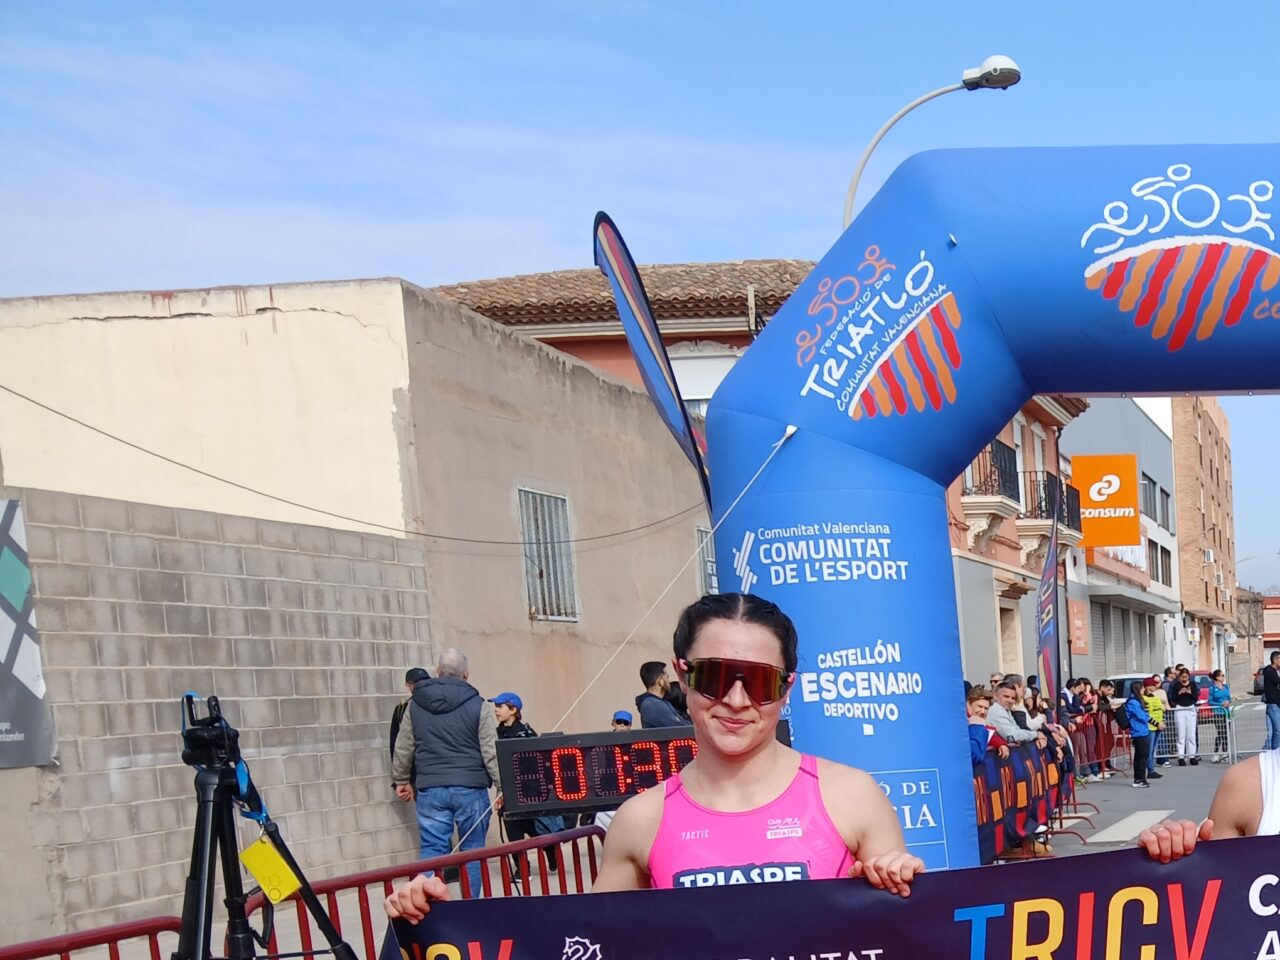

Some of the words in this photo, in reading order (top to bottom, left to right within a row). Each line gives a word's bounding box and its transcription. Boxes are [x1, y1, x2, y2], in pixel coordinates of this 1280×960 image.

[800, 250, 934, 399] TRIATLÓ
[820, 288, 872, 356] FEDERACIÓ
[874, 273, 892, 291] DE
[836, 341, 881, 412] COMUNITAT
[882, 283, 947, 343] VALENCIANA
[1081, 507, 1135, 518] consum
[758, 524, 820, 540] Comunitat
[822, 521, 890, 535] Valenciana
[759, 538, 891, 564] COMUNITAT
[770, 565, 798, 585] DE
[805, 560, 908, 582] L'ESPORT
[817, 640, 900, 668] CASTELLÓN
[801, 671, 922, 703] ESCENARIO
[823, 703, 899, 721] DEPORTIVO
[903, 781, 931, 795] DE
[681, 829, 710, 840] TACTIC
